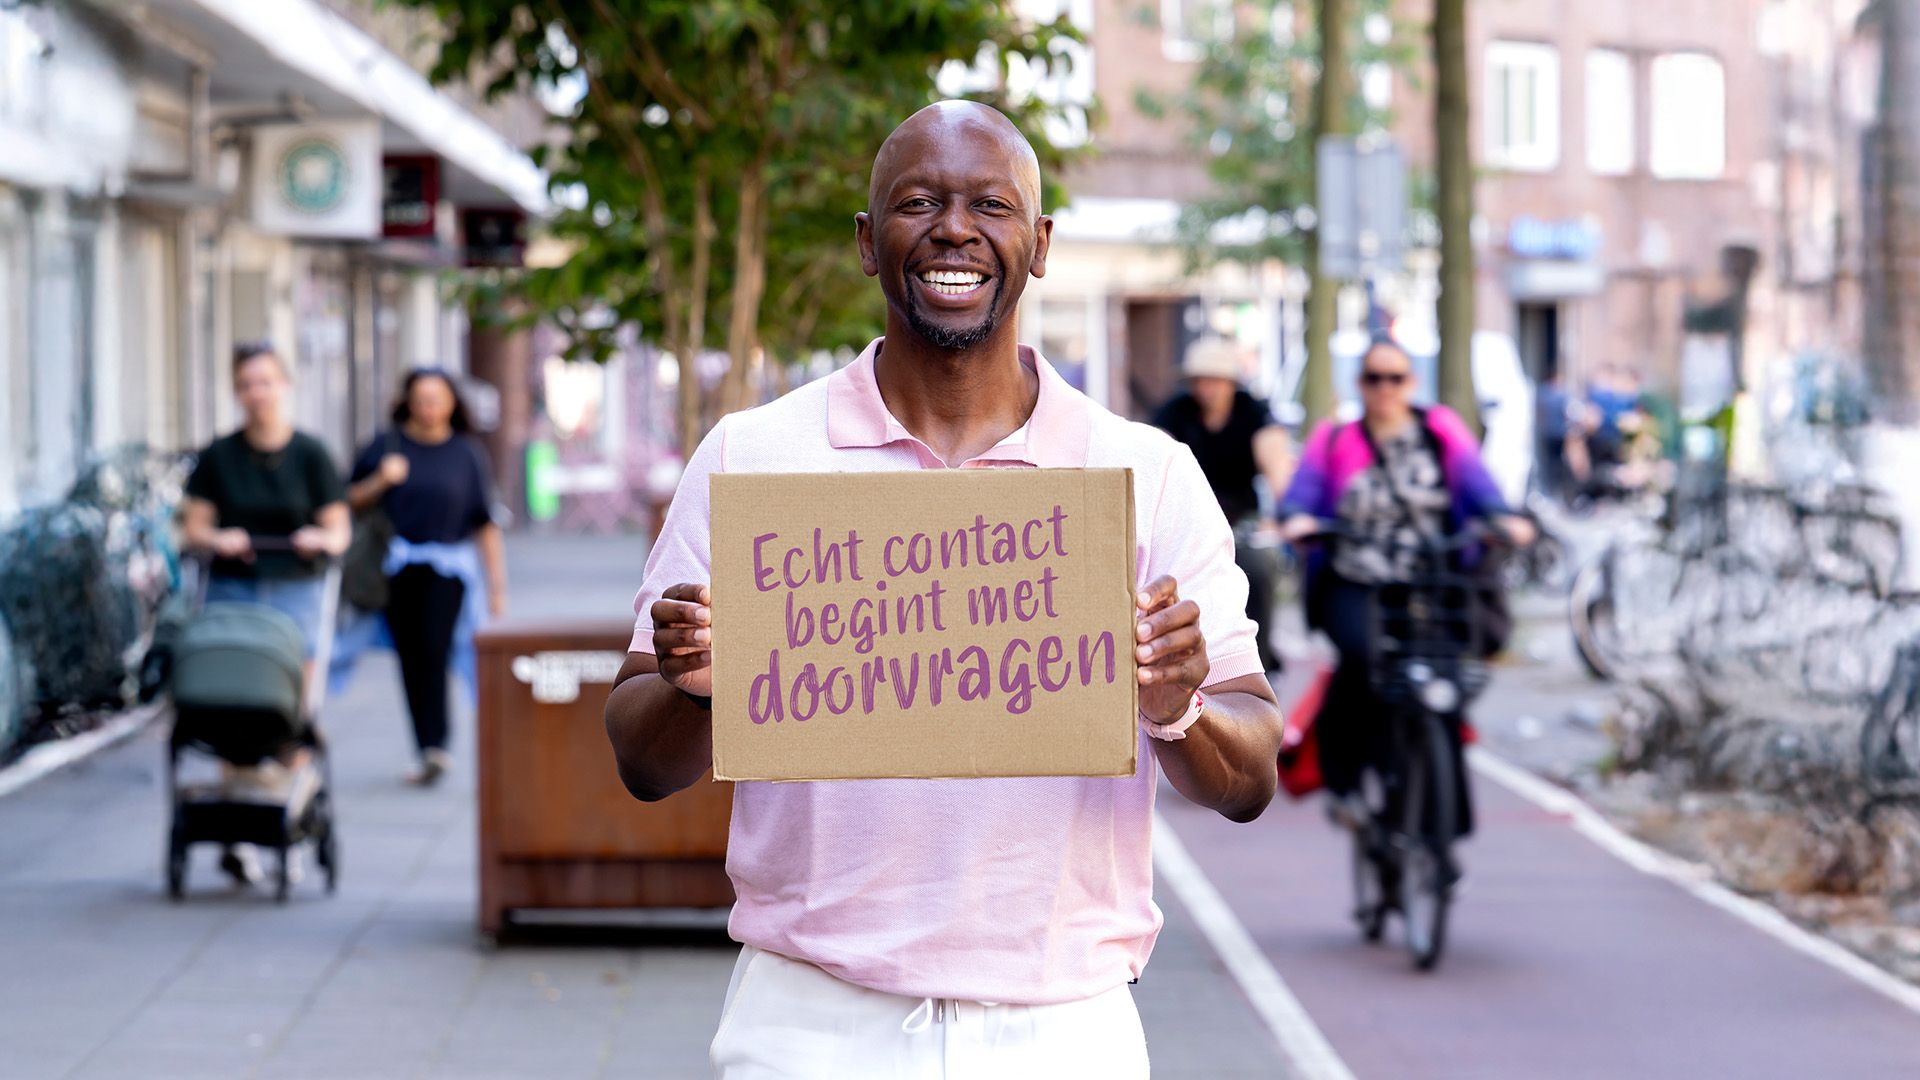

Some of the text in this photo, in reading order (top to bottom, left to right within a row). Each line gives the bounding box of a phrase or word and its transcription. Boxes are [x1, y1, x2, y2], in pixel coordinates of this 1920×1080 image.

[753, 505, 1068, 592] Echt contact
[785, 567, 1059, 654] begint met
[748, 630, 1116, 725] doorvragen
